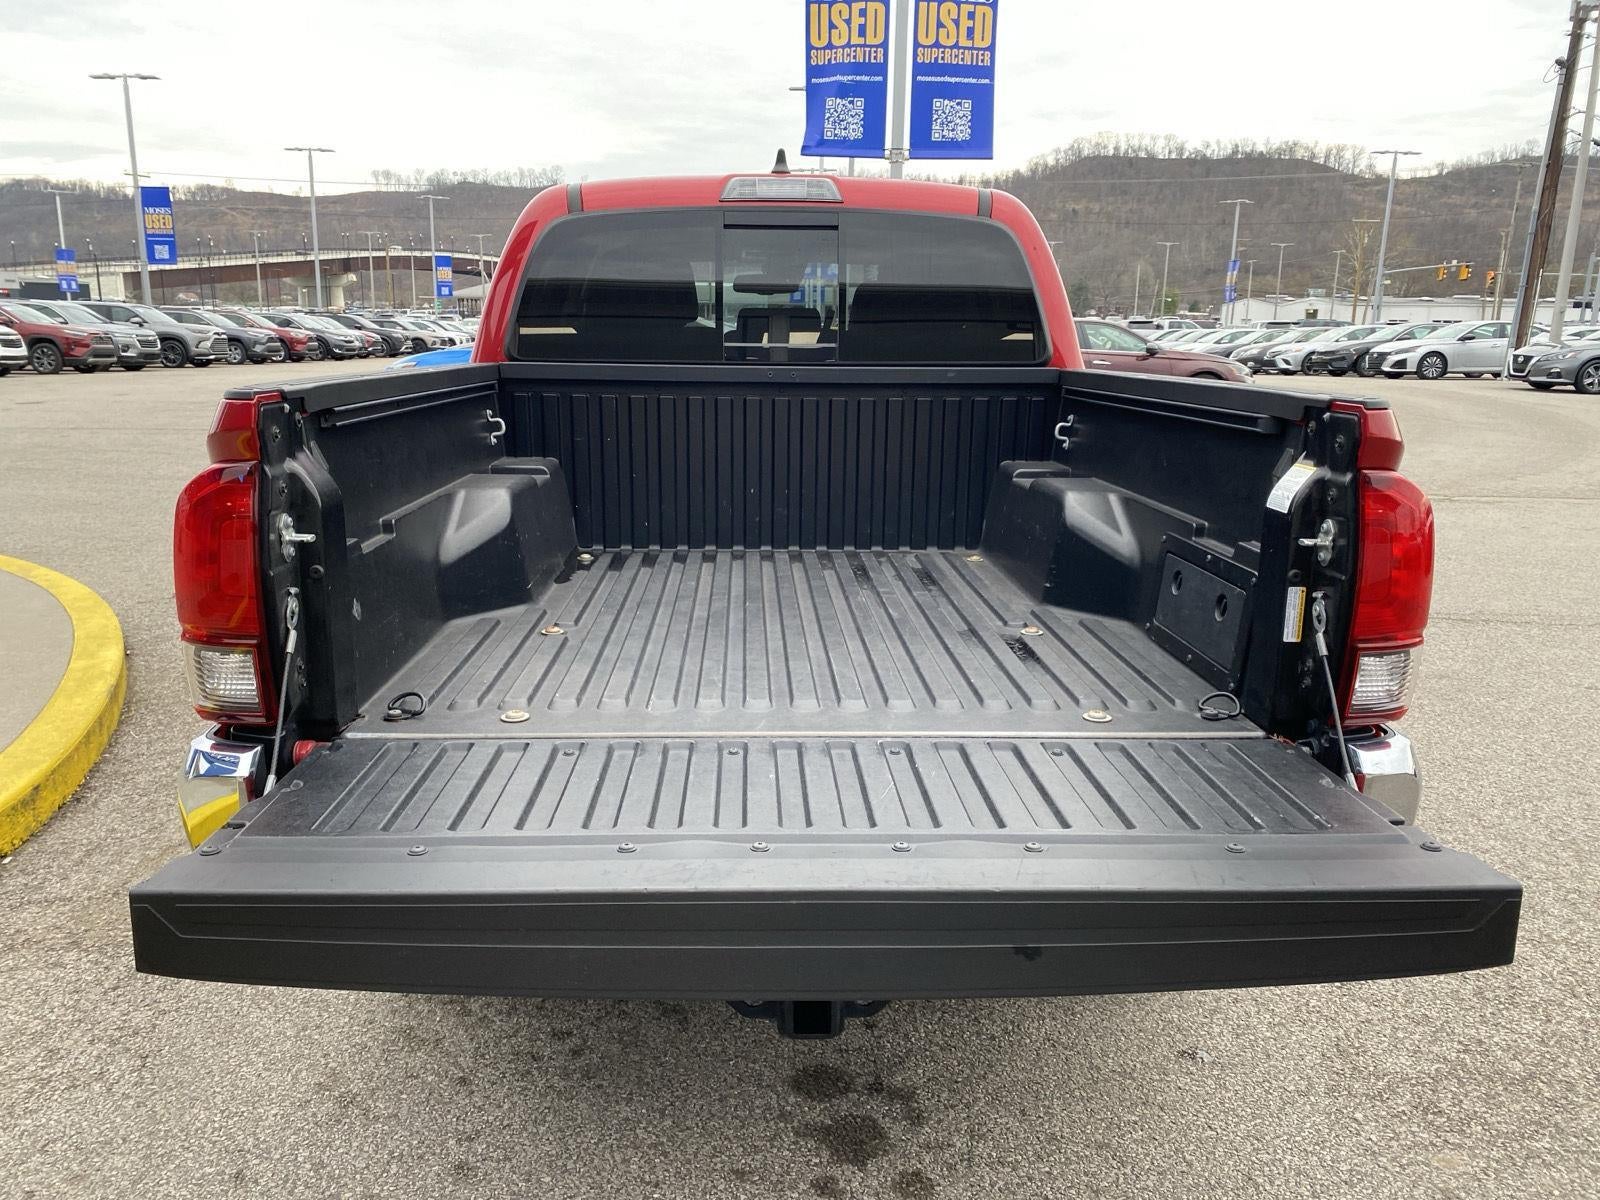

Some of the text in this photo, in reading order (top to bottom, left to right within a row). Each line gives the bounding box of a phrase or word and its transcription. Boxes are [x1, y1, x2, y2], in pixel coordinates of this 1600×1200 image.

[810, 2, 885, 47] USED
[917, 2, 993, 48] USED
[810, 48, 884, 65] SUPERCENTER
[916, 48, 991, 66] SUPERCENTER
[811, 74, 883, 83] mosesusedsupercenter.com
[916, 75, 991, 84] mosesusedsupercenter.com
[145, 214, 173, 228] USED
